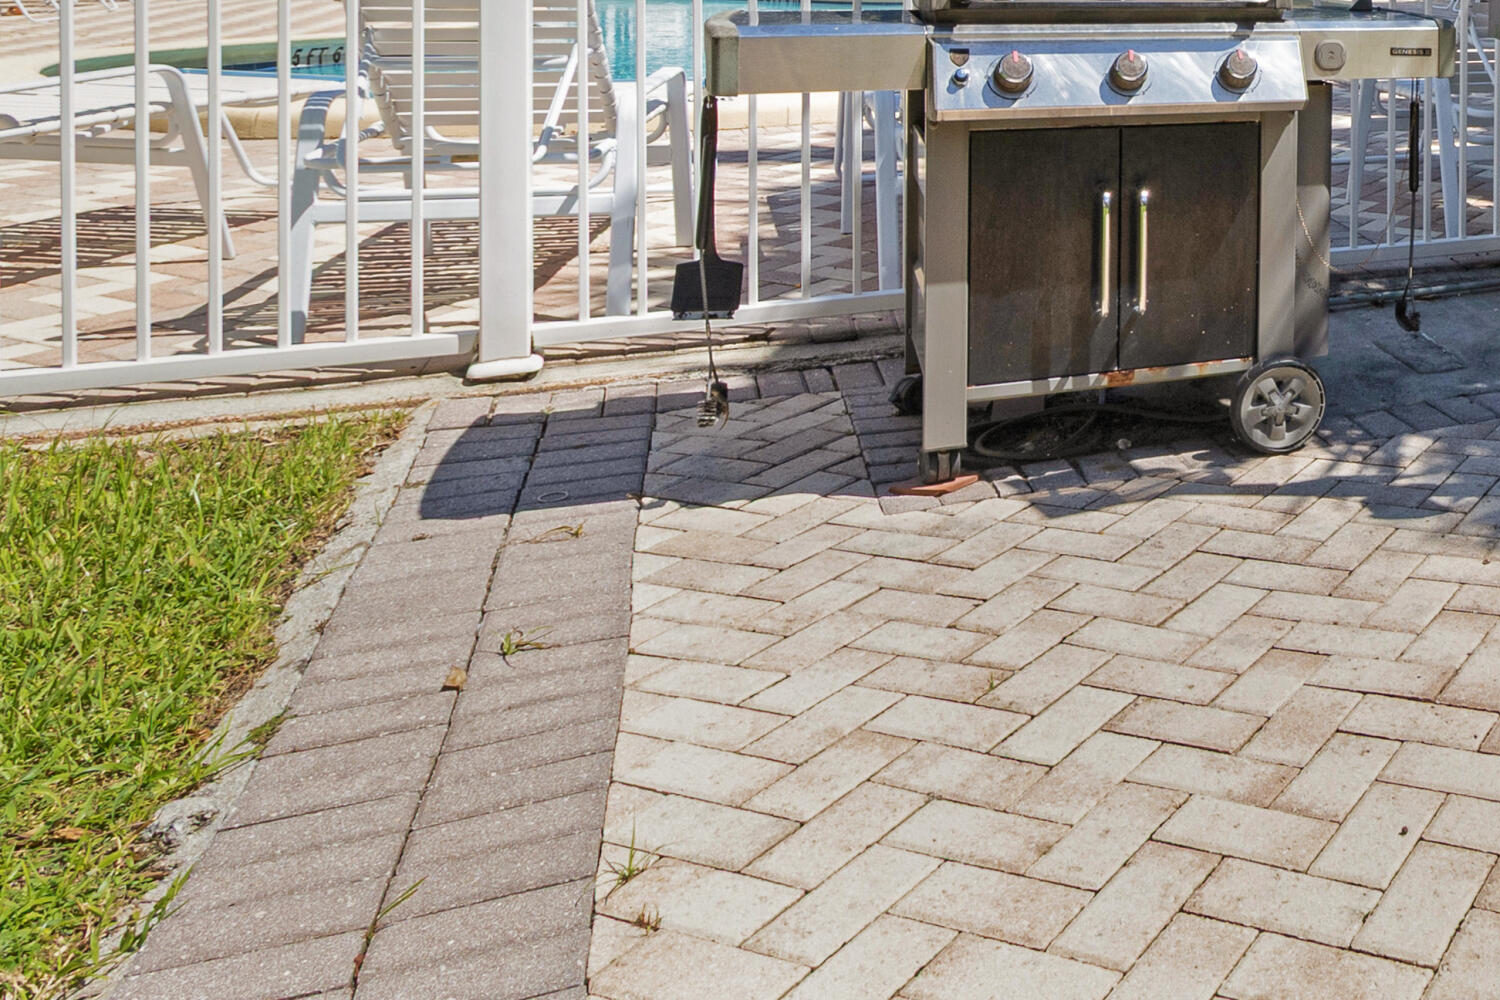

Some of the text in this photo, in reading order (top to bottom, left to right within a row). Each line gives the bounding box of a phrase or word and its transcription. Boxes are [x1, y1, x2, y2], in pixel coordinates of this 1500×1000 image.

[291, 46, 344, 66] 5 FT 6
